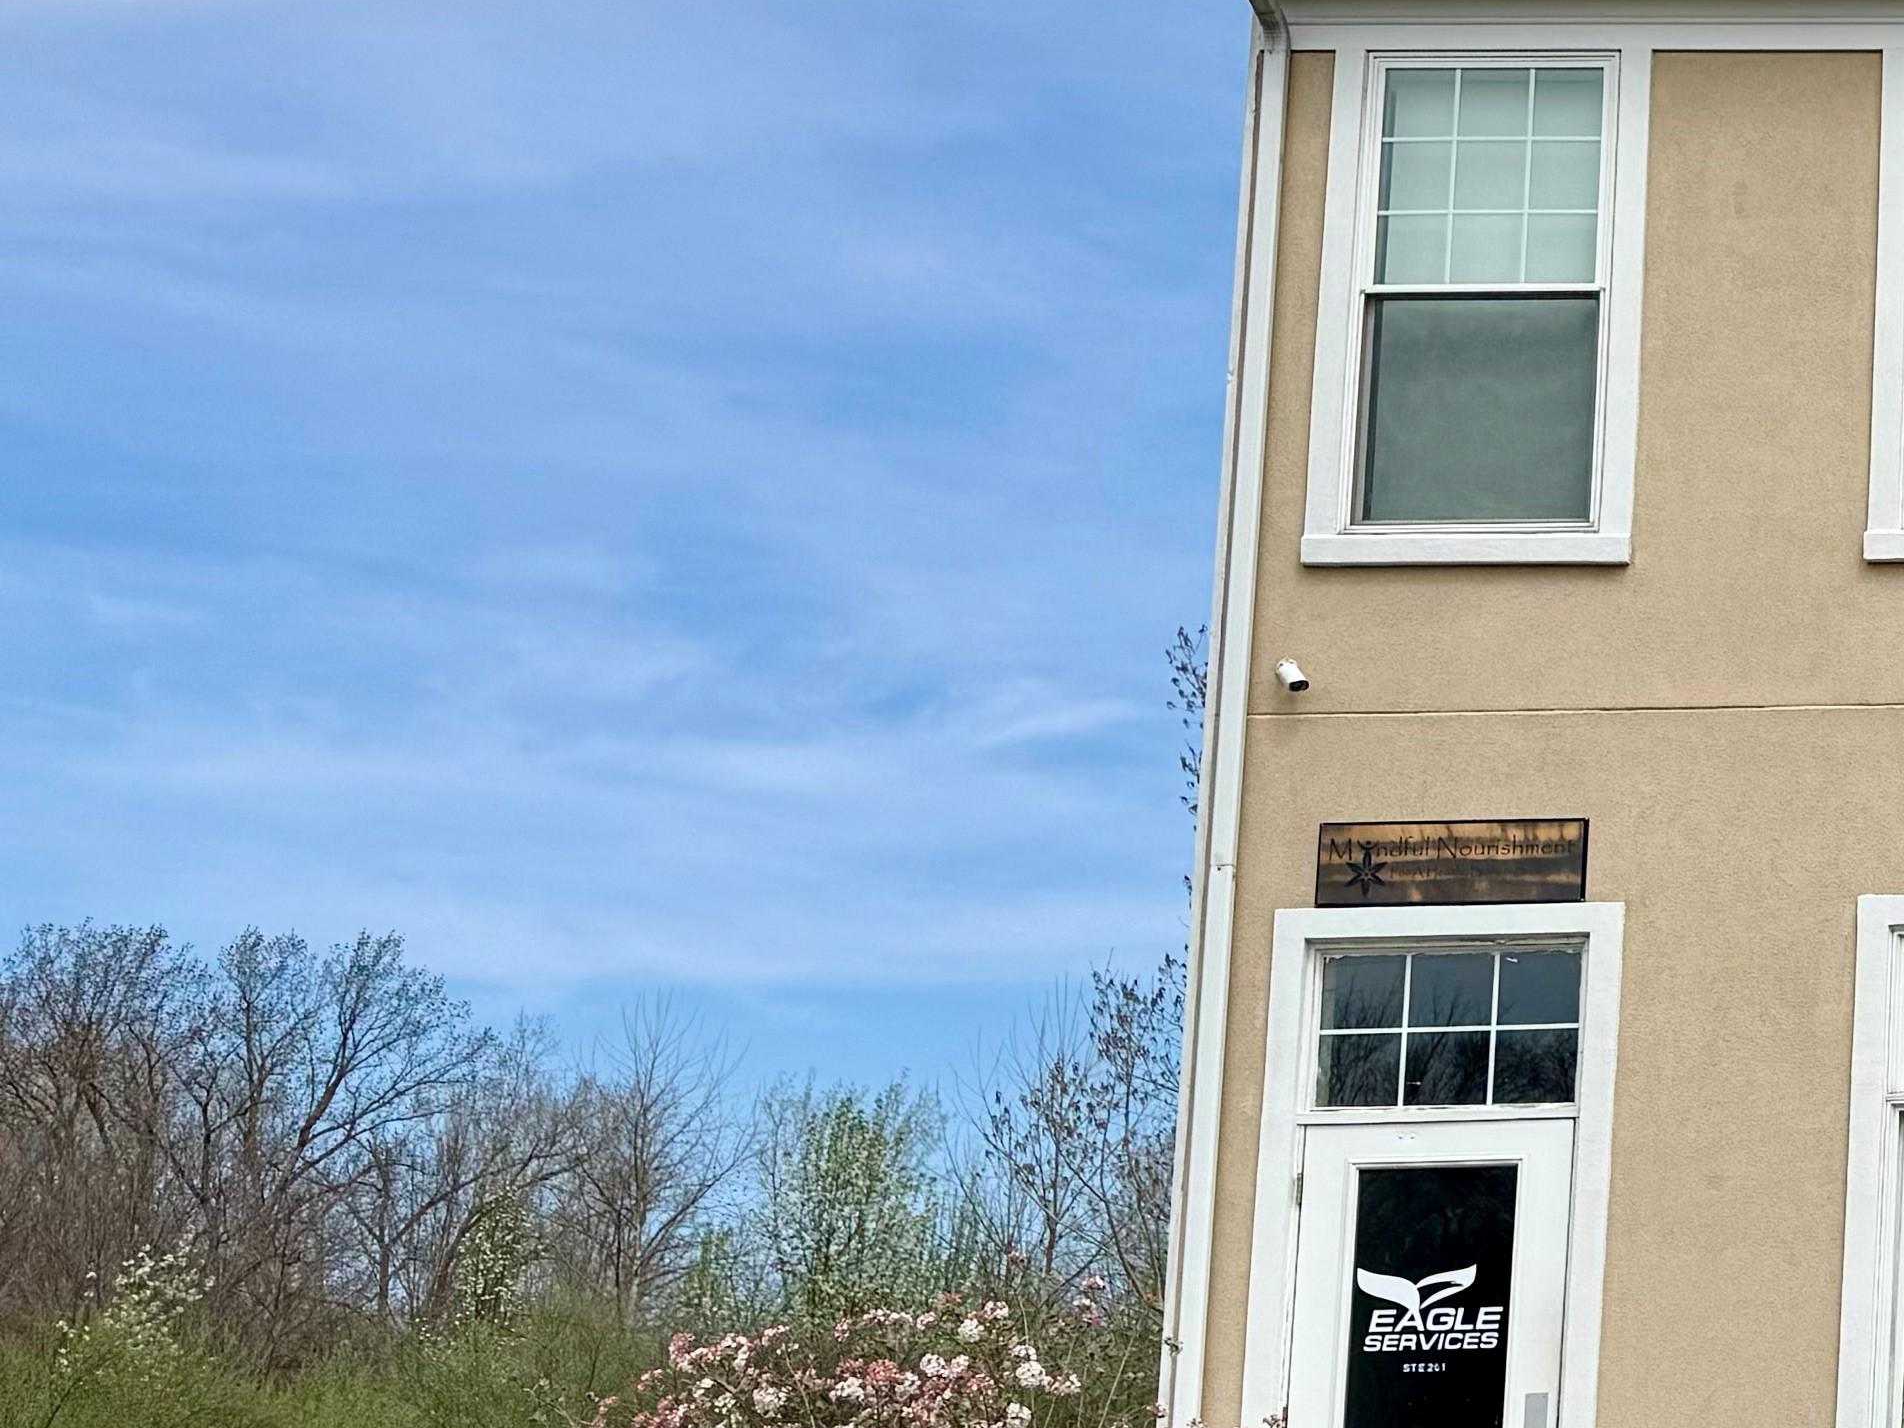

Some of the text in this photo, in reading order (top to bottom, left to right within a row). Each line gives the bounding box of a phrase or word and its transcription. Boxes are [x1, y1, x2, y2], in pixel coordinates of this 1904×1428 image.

[1436, 834, 1575, 861] Nourishment
[1368, 1306, 1504, 1333] EAGLE
[1363, 1332, 1499, 1352] SERVICES
